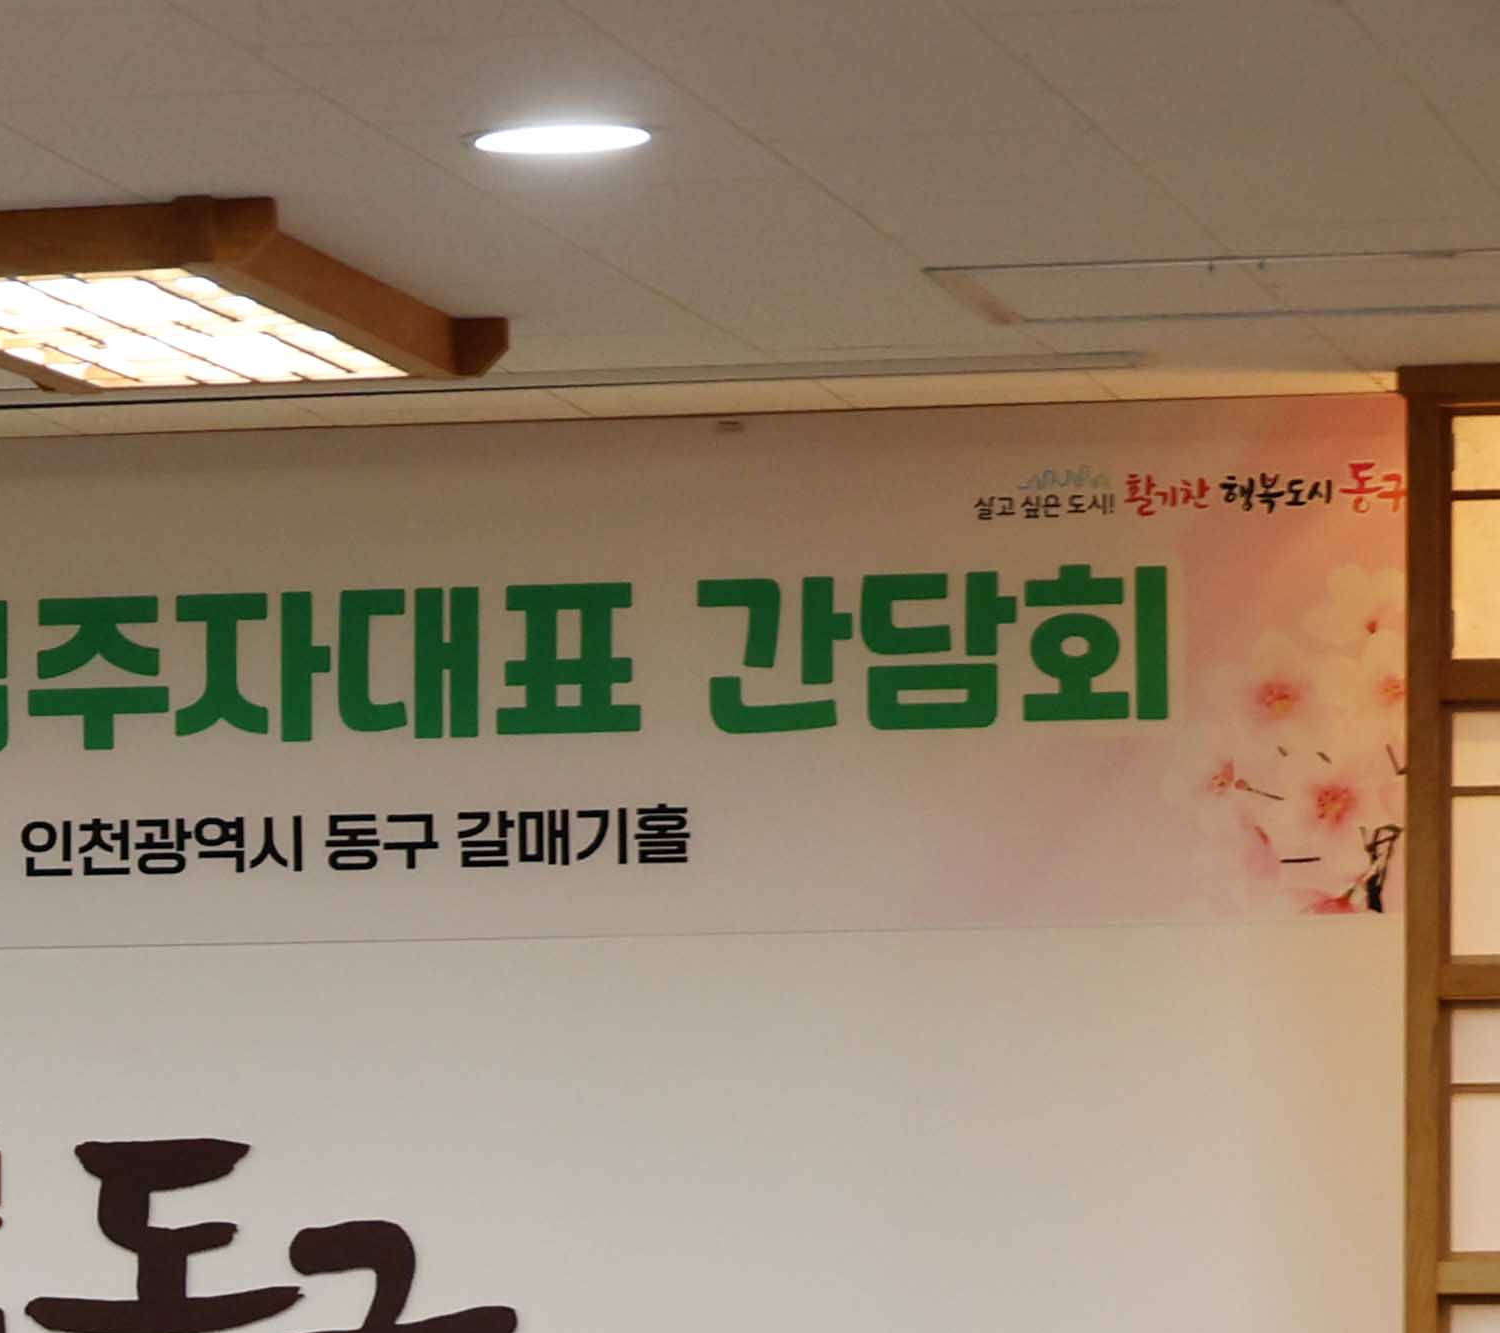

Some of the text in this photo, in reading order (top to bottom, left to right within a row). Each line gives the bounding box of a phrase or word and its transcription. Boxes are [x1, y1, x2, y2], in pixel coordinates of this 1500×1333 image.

[972, 492, 1115, 521] 살고 싶은 도시!
[1123, 461, 1407, 517] 활기찬 행복도시 동구
[698, 565, 1170, 735] 간담회
[19, 802, 692, 878] 인천광역시 동구 갈매기홀
